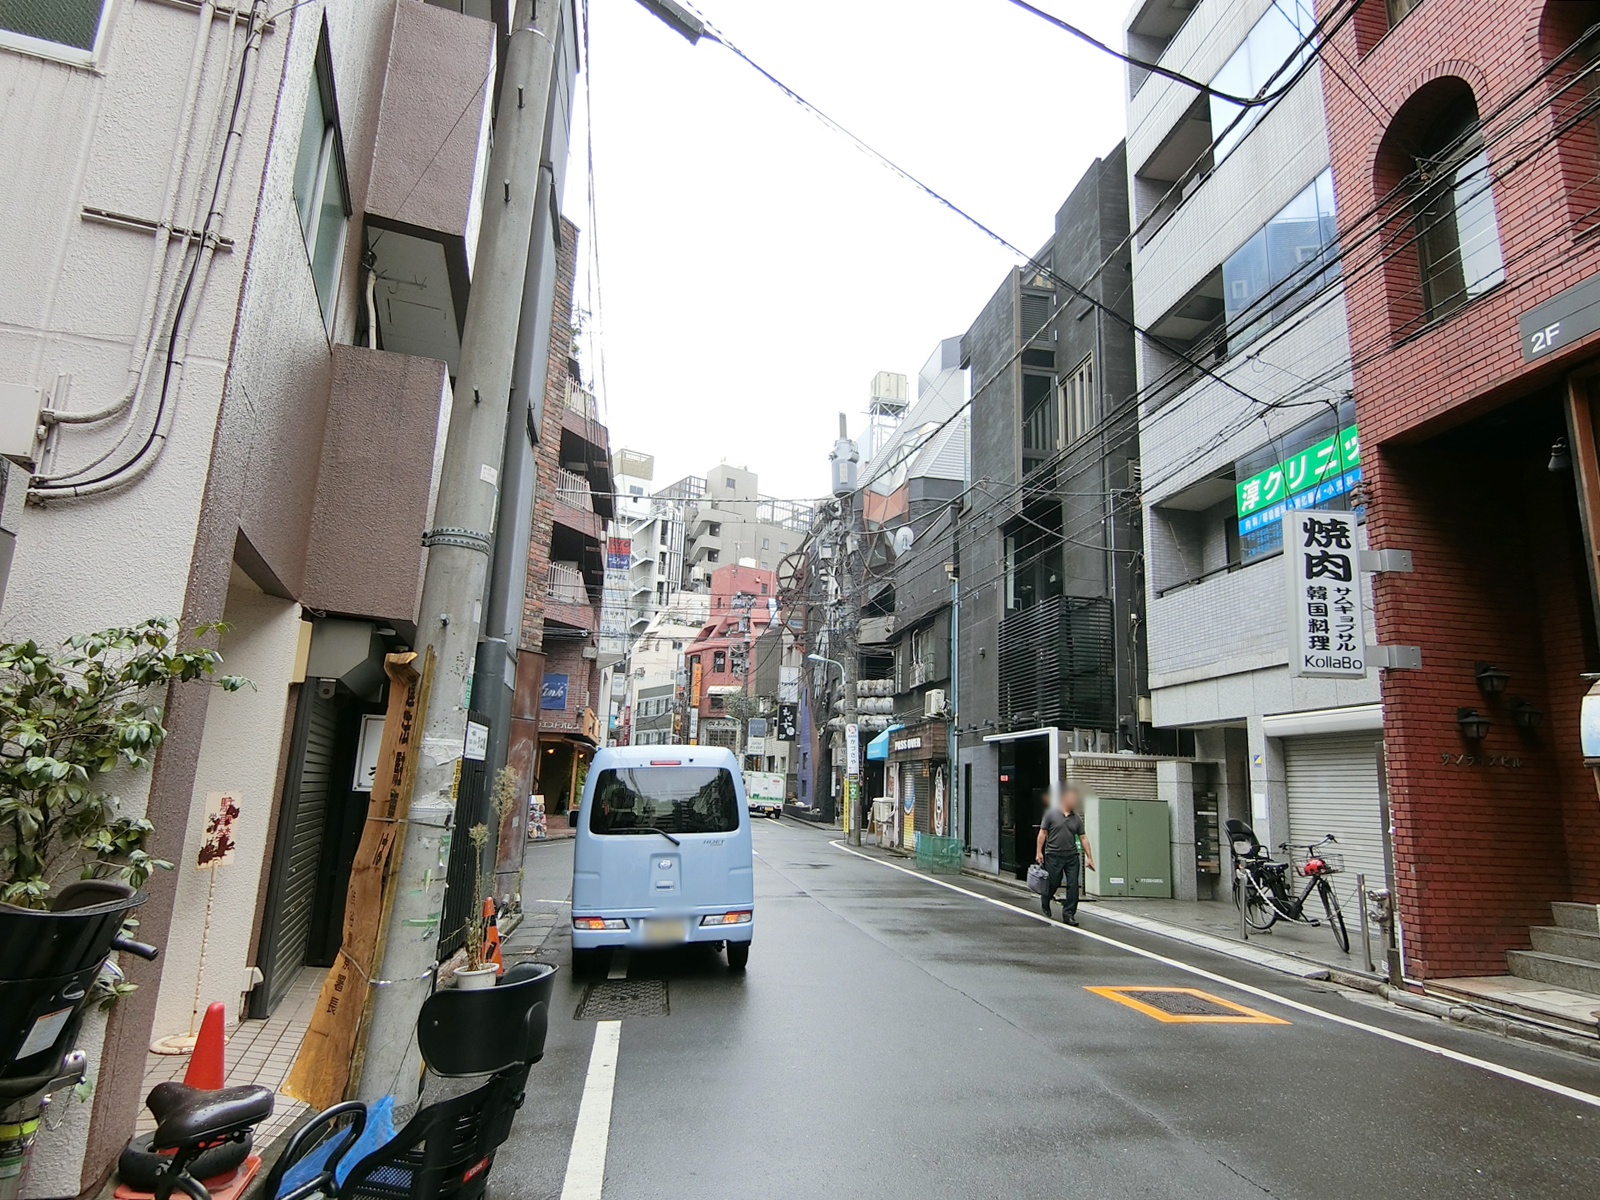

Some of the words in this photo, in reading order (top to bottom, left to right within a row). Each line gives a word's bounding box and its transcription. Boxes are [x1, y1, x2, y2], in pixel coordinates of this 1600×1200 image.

[1530, 321, 1561, 354] 2F
[1302, 517, 1353, 583] 焼肉
[1306, 585, 1331, 651] 韓国料理
[1304, 654, 1363, 670] KollaBo
